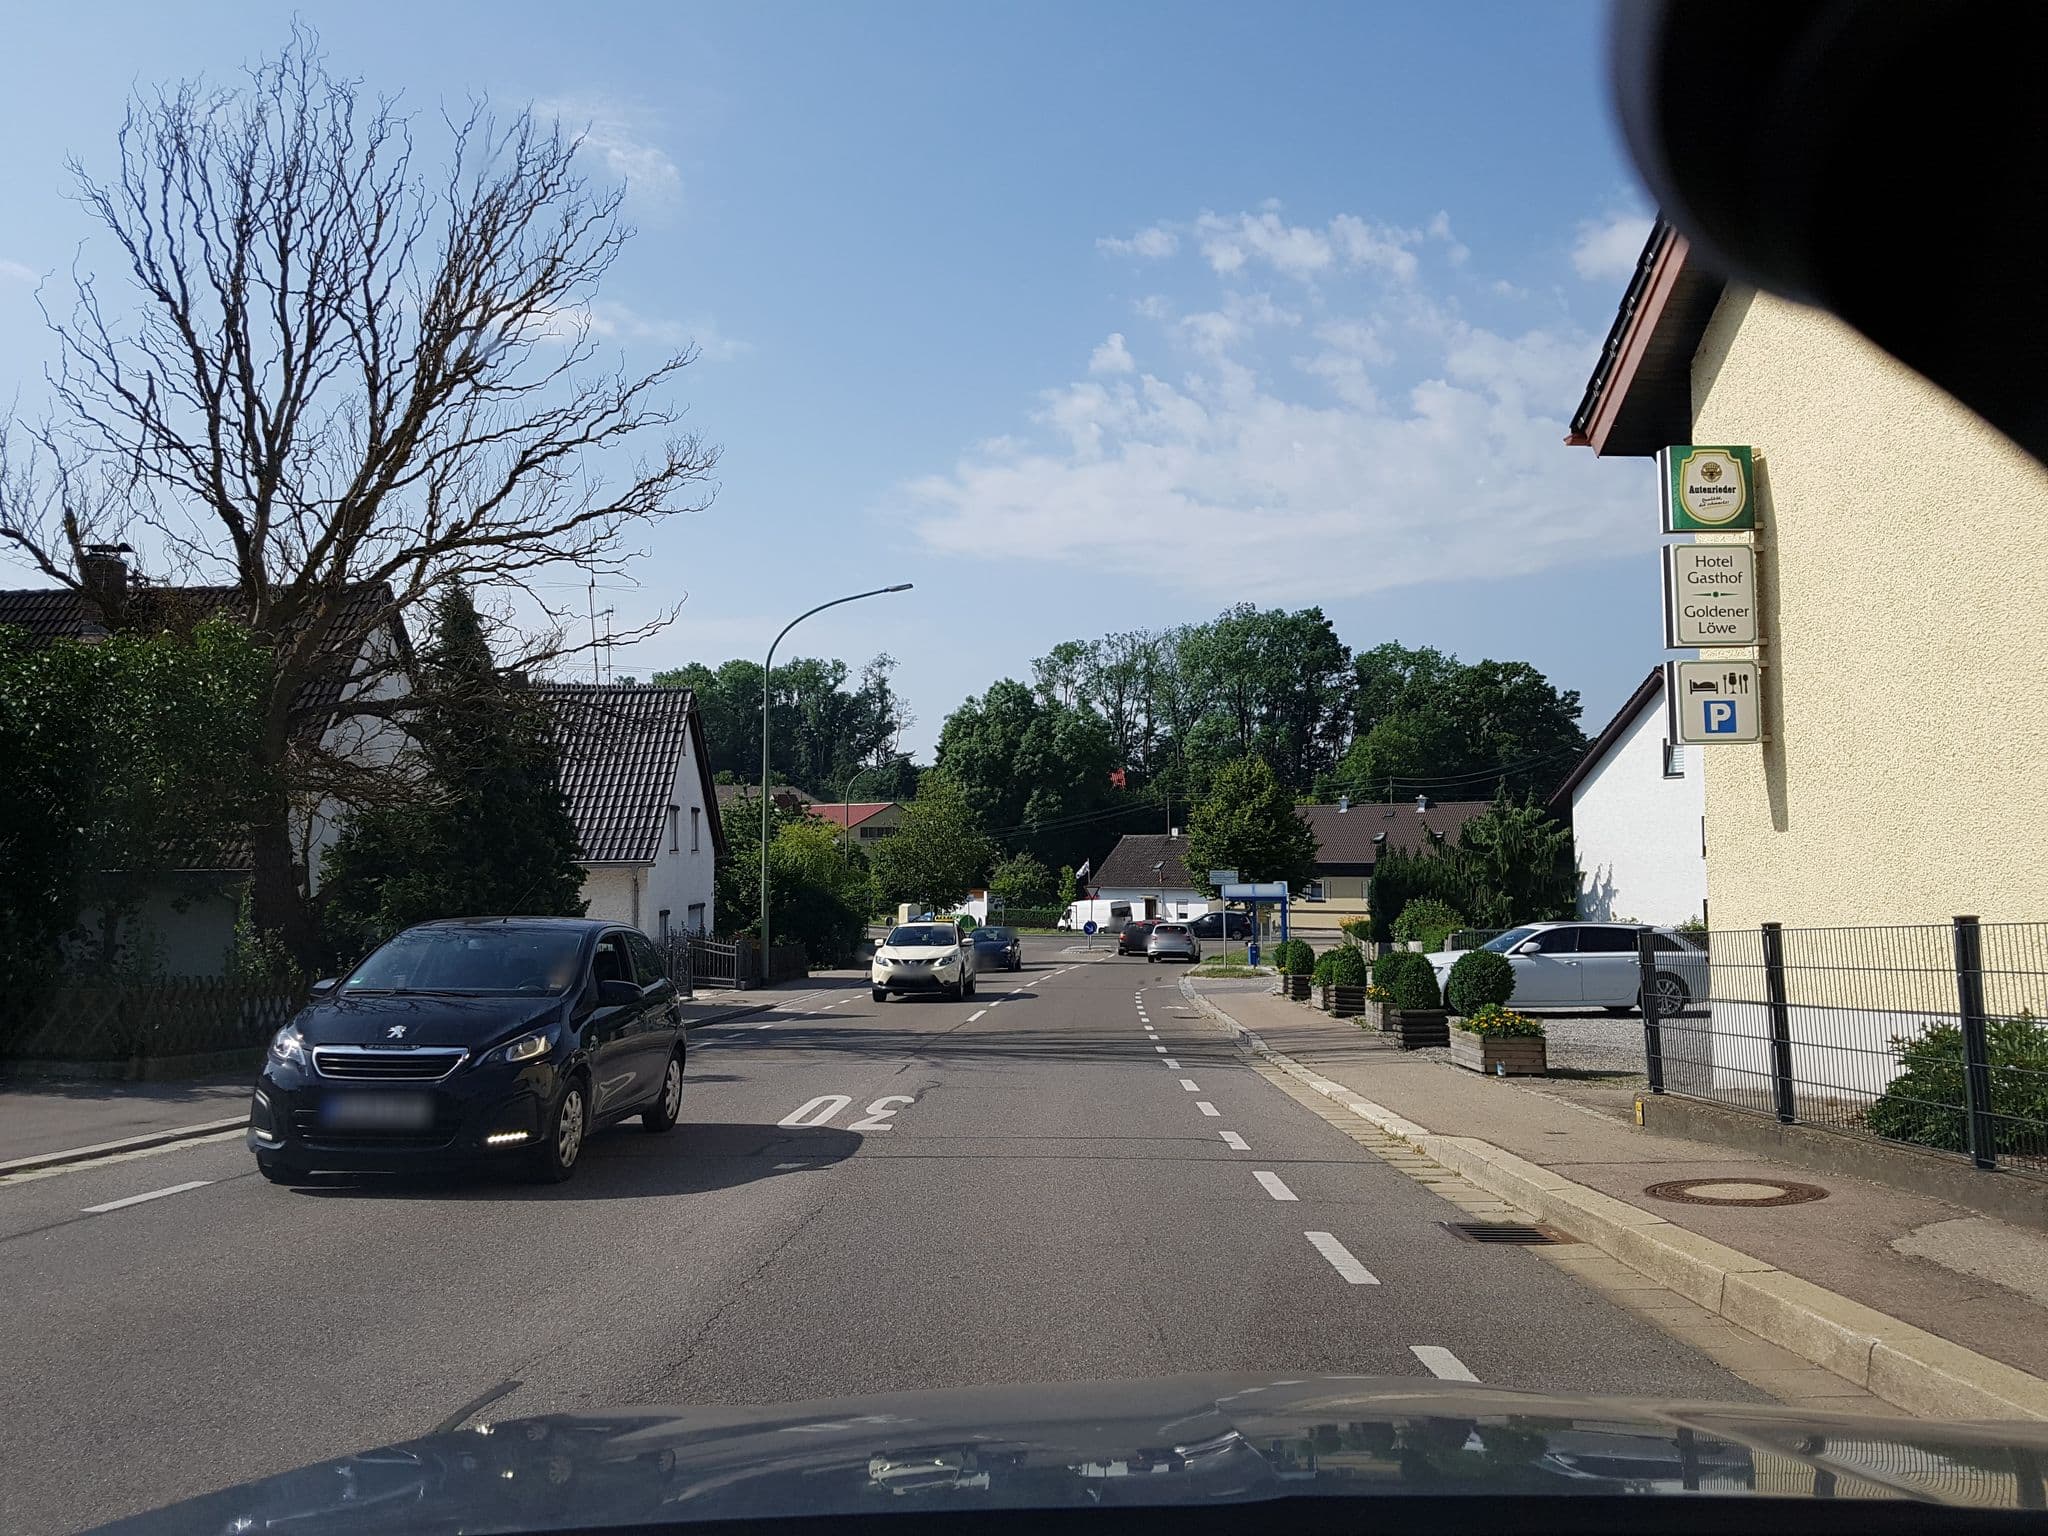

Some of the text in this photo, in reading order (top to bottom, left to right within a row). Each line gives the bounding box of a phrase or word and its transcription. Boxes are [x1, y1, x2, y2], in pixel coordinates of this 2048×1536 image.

[1695, 555, 1733, 568] Hotel
[1687, 572, 1743, 584] Gasthof
[1684, 605, 1749, 618] Goldener
[1698, 622, 1737, 634] Löwe
[1709, 703, 1731, 731] P
[776, 1095, 915, 1131] 30
